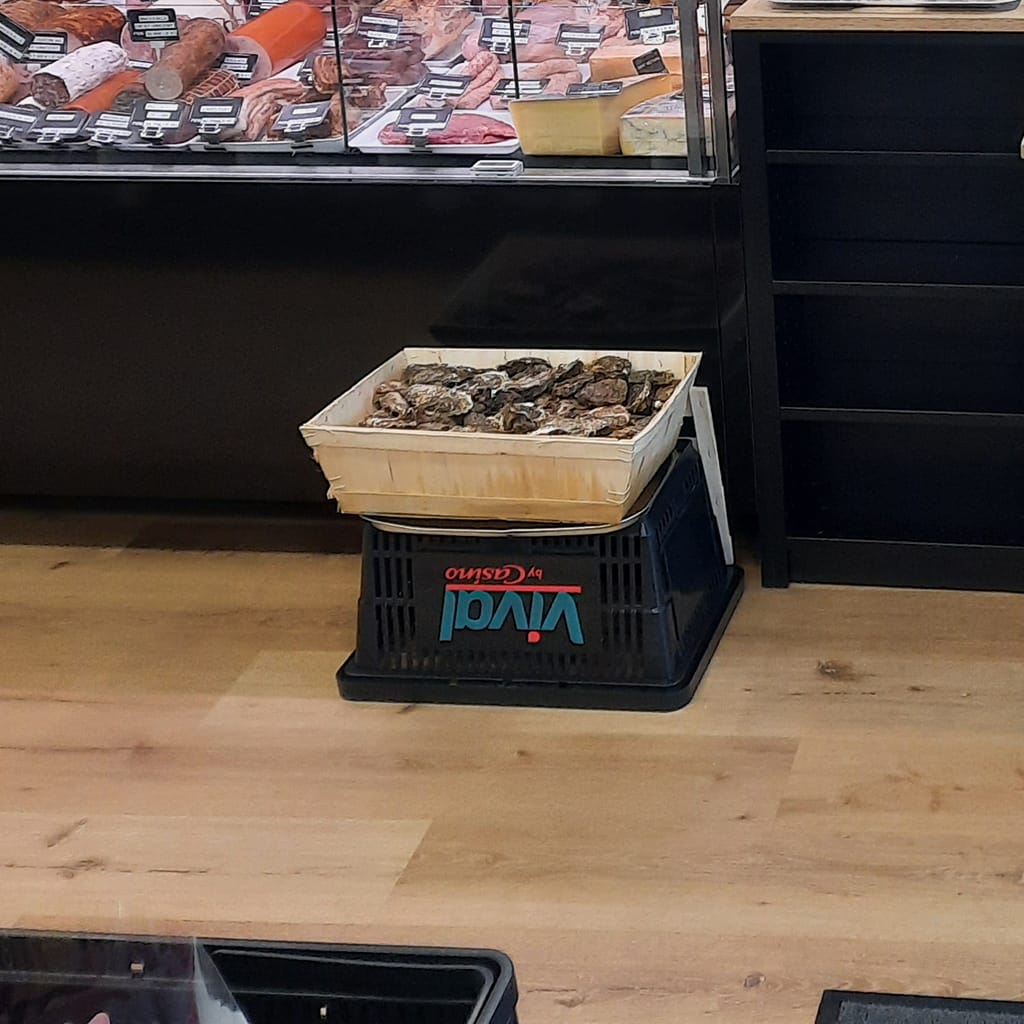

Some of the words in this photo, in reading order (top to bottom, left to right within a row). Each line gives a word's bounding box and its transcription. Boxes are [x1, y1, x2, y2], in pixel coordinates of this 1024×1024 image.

[444, 564, 525, 585] Casino
[528, 566, 543, 579] by
[440, 590, 584, 645] Vival
